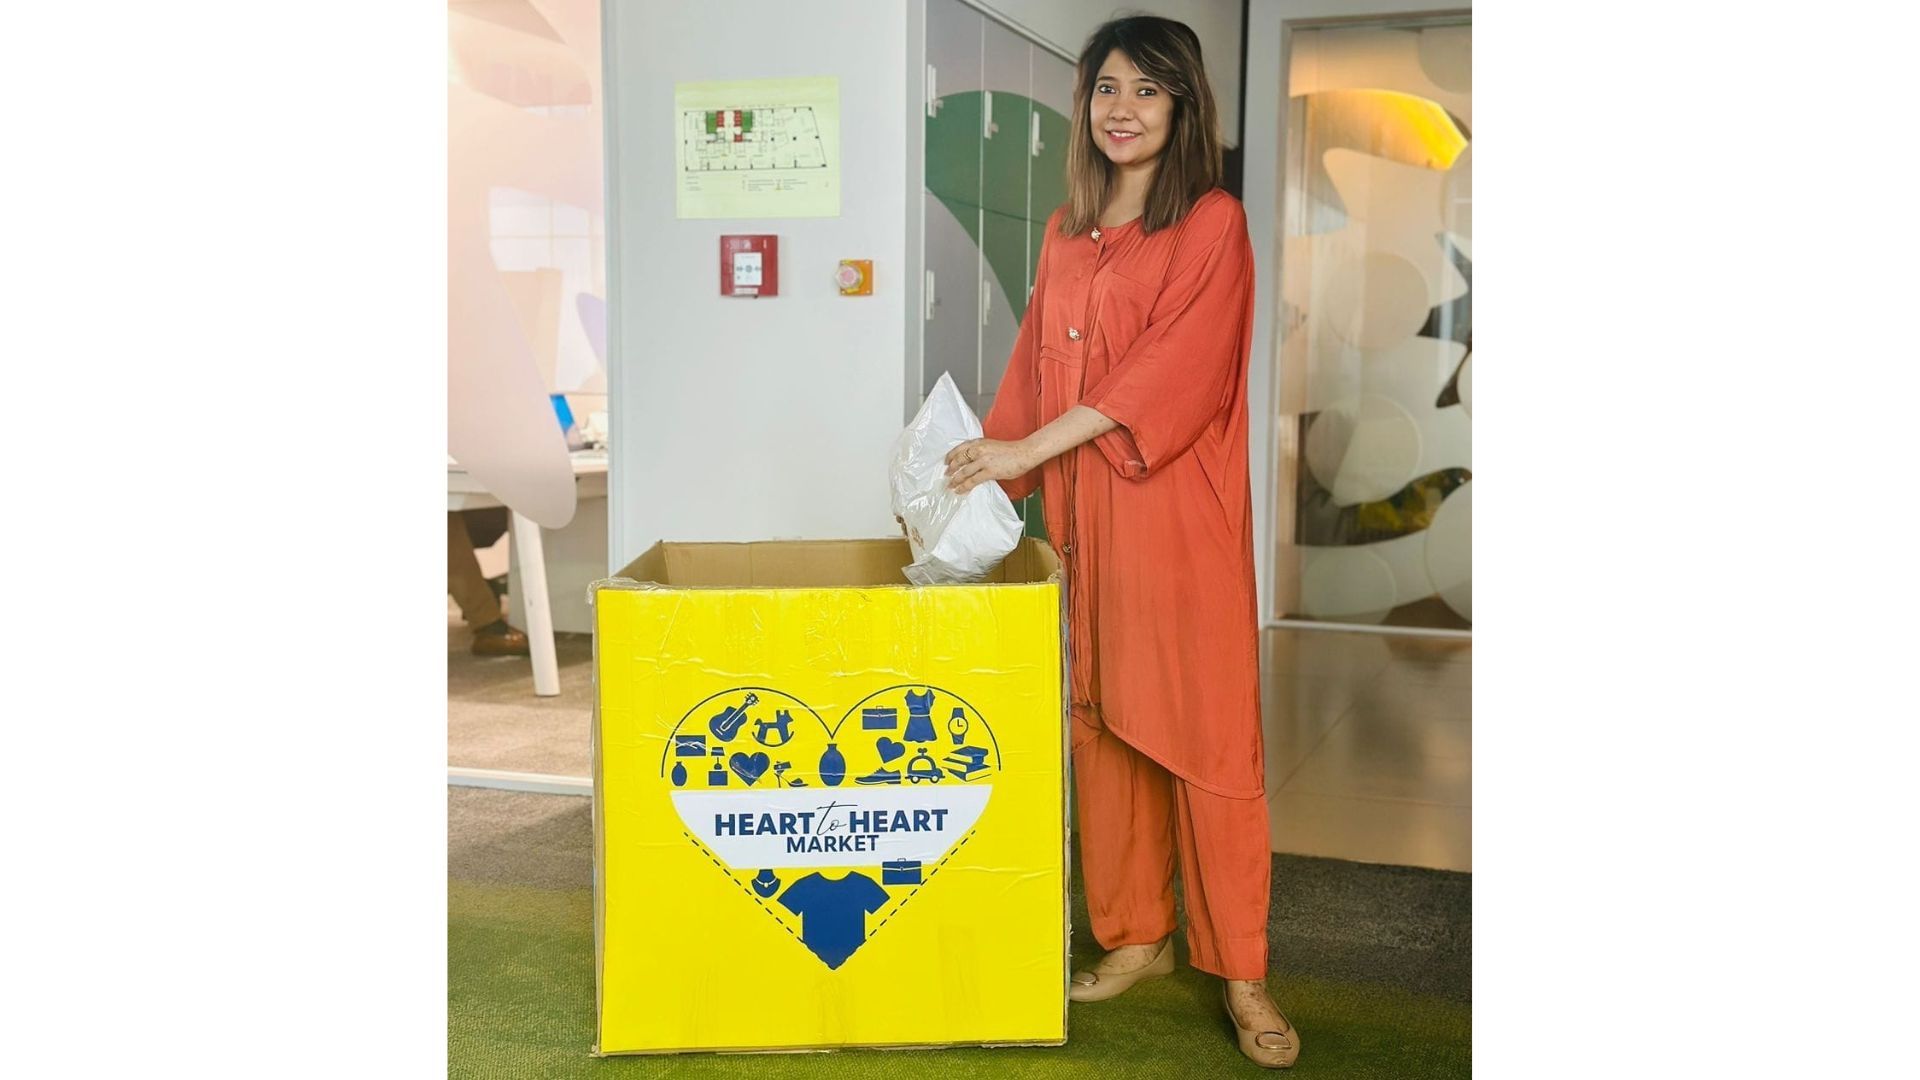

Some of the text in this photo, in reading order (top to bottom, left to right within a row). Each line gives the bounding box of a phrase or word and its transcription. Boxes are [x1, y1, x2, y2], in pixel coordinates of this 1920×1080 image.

[714, 800, 949, 836] HEART to HEART
[786, 834, 880, 853] MARKET
